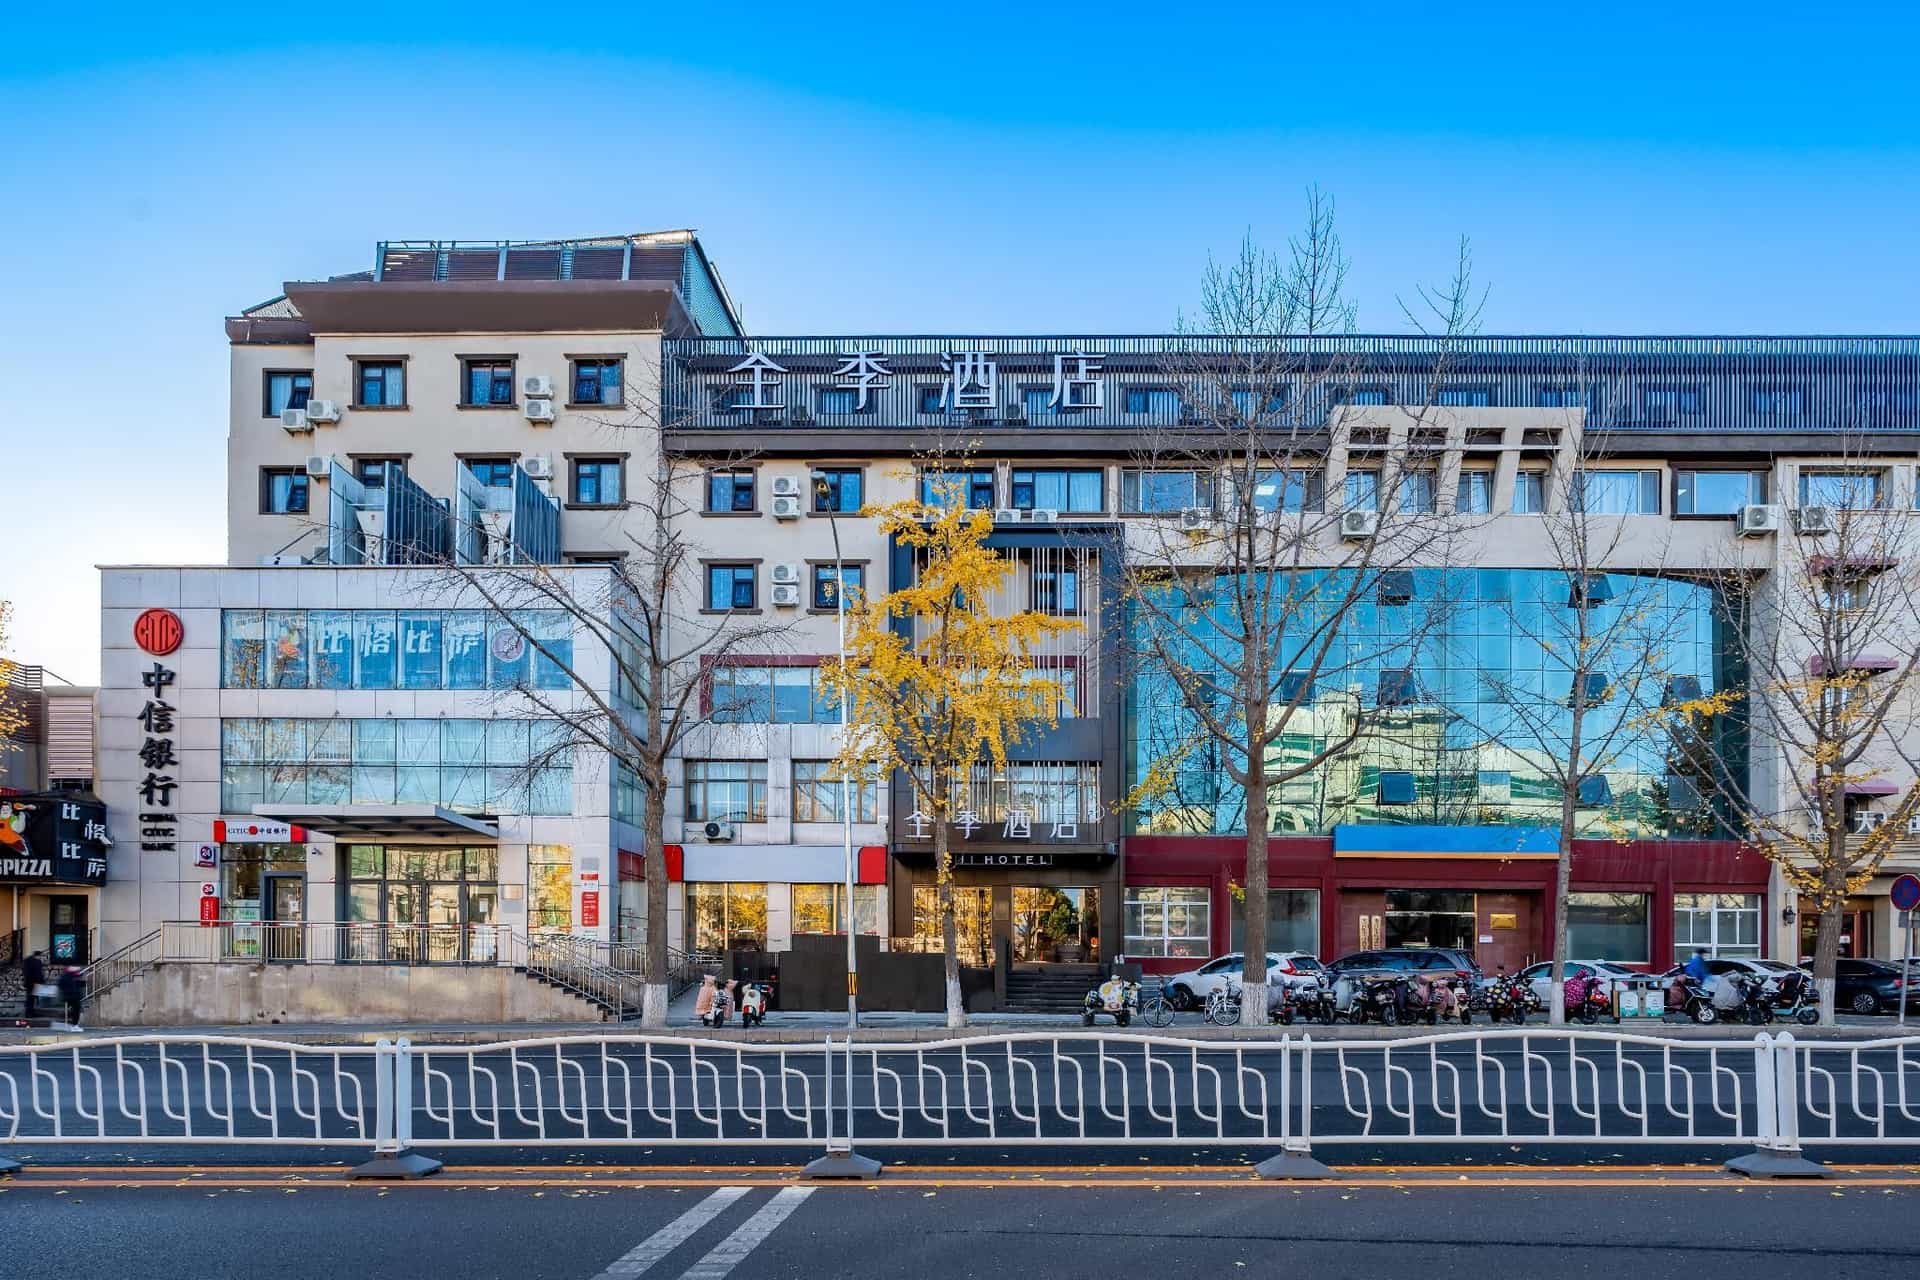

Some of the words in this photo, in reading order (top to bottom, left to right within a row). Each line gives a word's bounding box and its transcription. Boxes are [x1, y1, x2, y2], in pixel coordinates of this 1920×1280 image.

[727, 348, 1106, 410] 全季酒店
[317, 625, 481, 661] 比格比萨
[137, 662, 179, 808] 中信银行
[904, 810, 1077, 839] 全季酒店
[0, 858, 53, 876] PIZZA
[984, 855, 1048, 865] HOTEL
